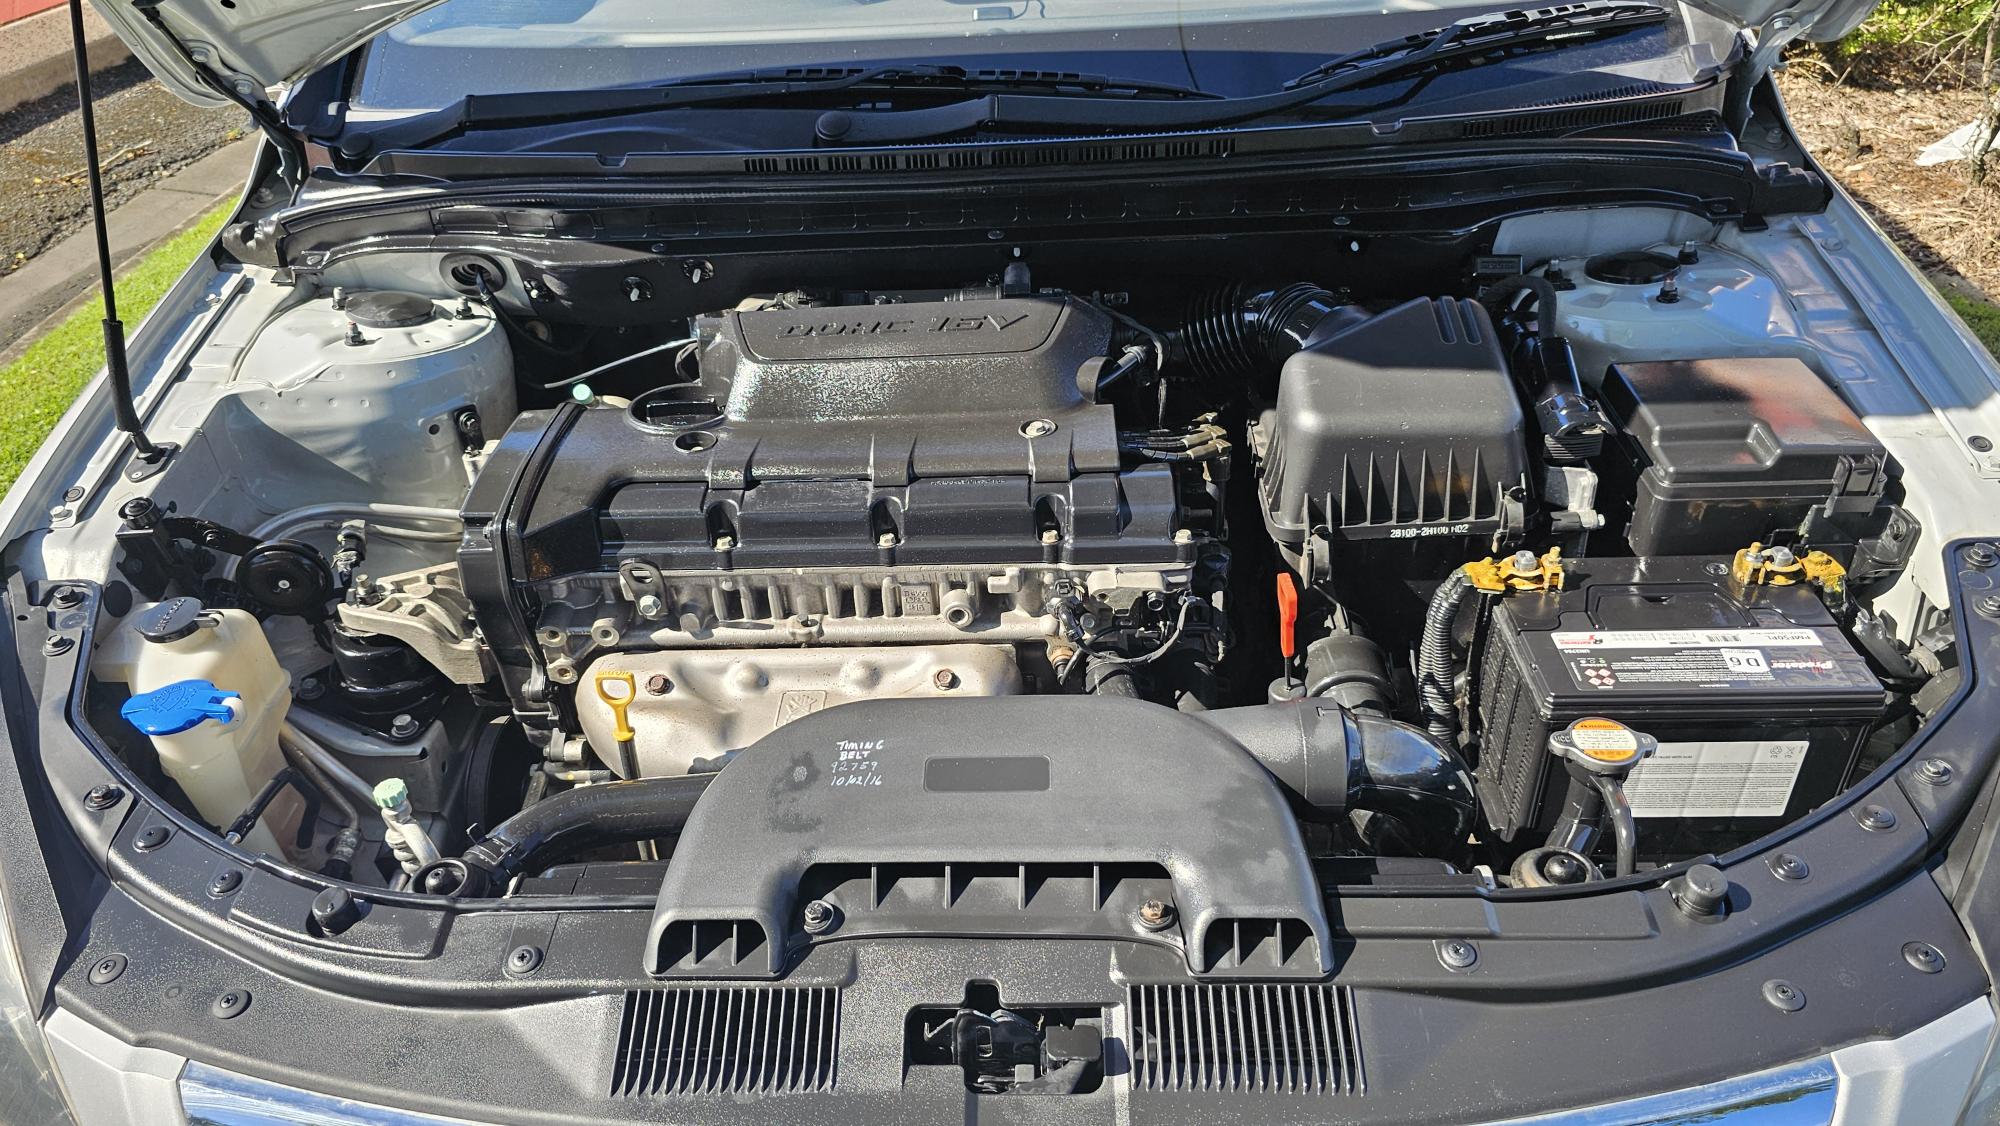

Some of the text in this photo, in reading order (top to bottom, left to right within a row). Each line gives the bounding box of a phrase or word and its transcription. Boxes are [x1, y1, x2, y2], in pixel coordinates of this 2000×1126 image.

[776, 313, 1030, 340] DOHC 16V
[1770, 660, 1833, 670] Predator
[836, 739, 884, 751] TIMING
[839, 751, 871, 761] BELT
[831, 761, 878, 773] 92759
